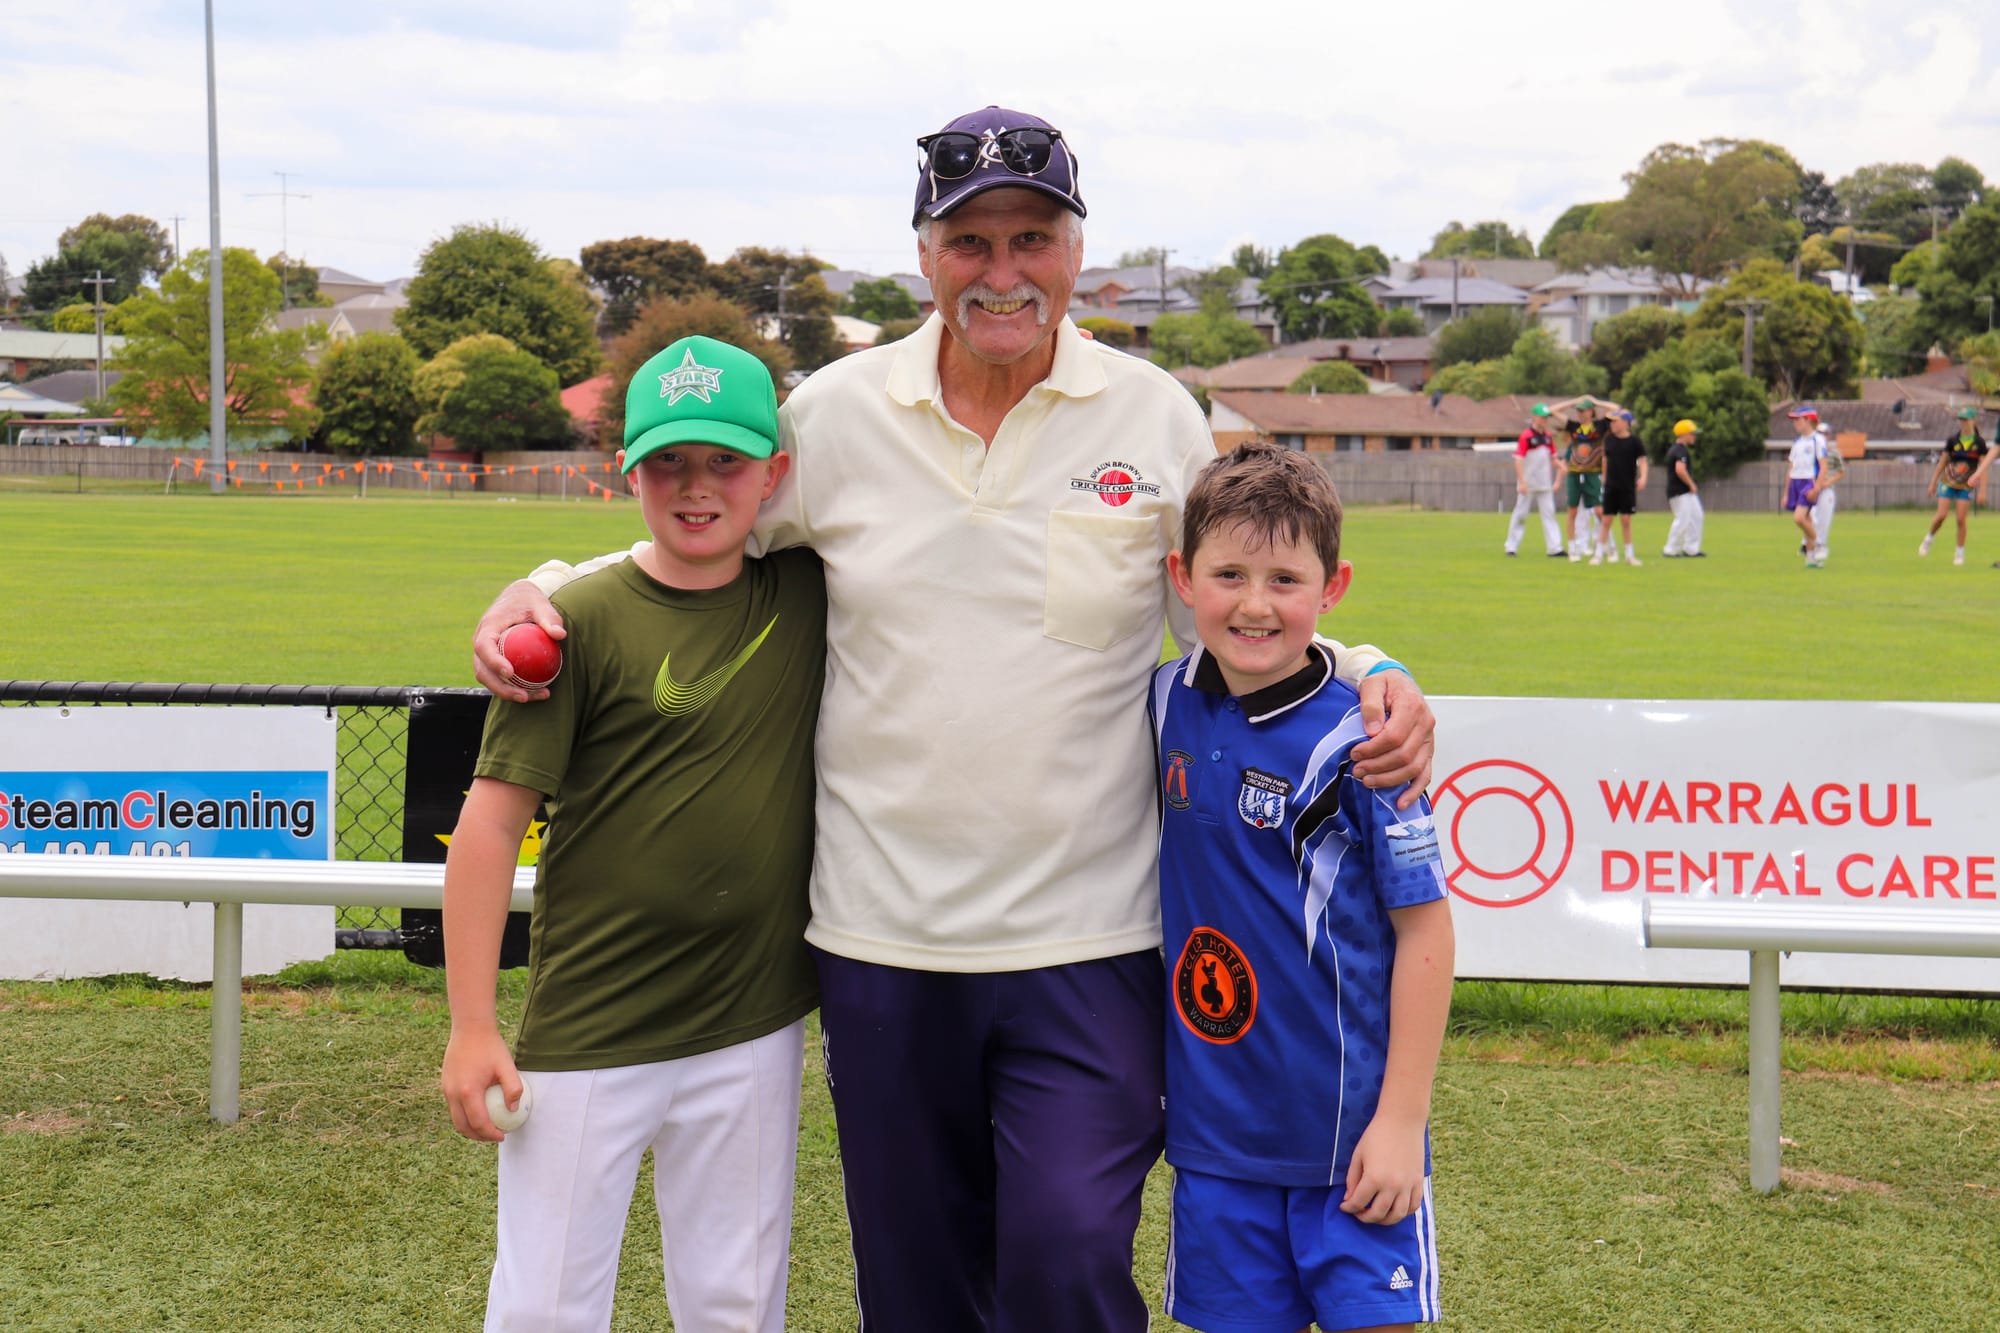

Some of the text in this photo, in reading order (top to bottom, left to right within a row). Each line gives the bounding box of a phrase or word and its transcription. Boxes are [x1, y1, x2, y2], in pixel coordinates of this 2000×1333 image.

[665, 371, 714, 387] STARS
[1090, 461, 1143, 481] SHAUN BROWN'S
[1071, 480, 1160, 495] CRICKET COACHING
[1245, 777, 1285, 794] CRICKET CLUB
[1246, 770, 1289, 789] WESTERN PARK
[1599, 779, 1932, 827] WARRAGUL
[1601, 850, 1997, 899] DENTAL CARE
[1209, 937, 1247, 984] HOTEL
[1190, 1007, 1240, 1034] WARRAGL
